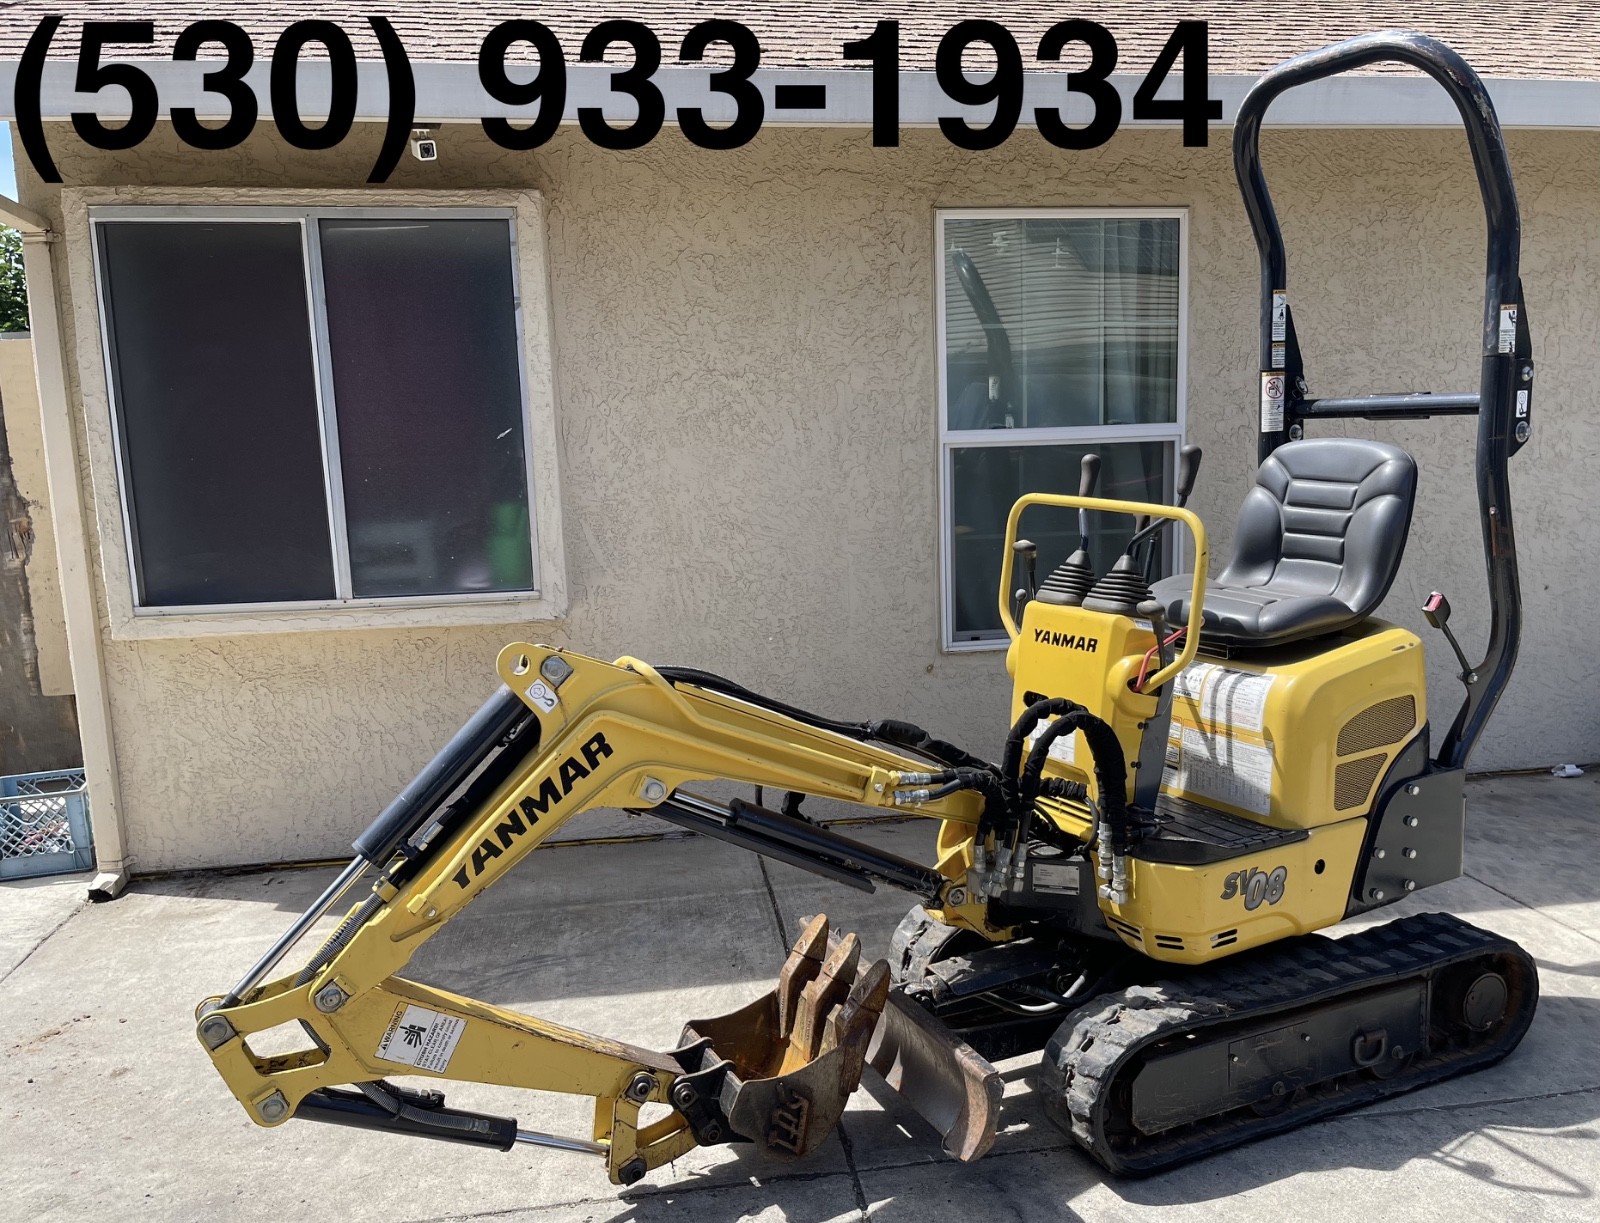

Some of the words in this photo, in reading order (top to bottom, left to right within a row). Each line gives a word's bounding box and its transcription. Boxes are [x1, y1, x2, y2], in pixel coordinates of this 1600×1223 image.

[1034, 628, 1098, 653] YANMAR
[452, 732, 614, 889] YANMAR
[383, 1010, 403, 1043] WARNING
